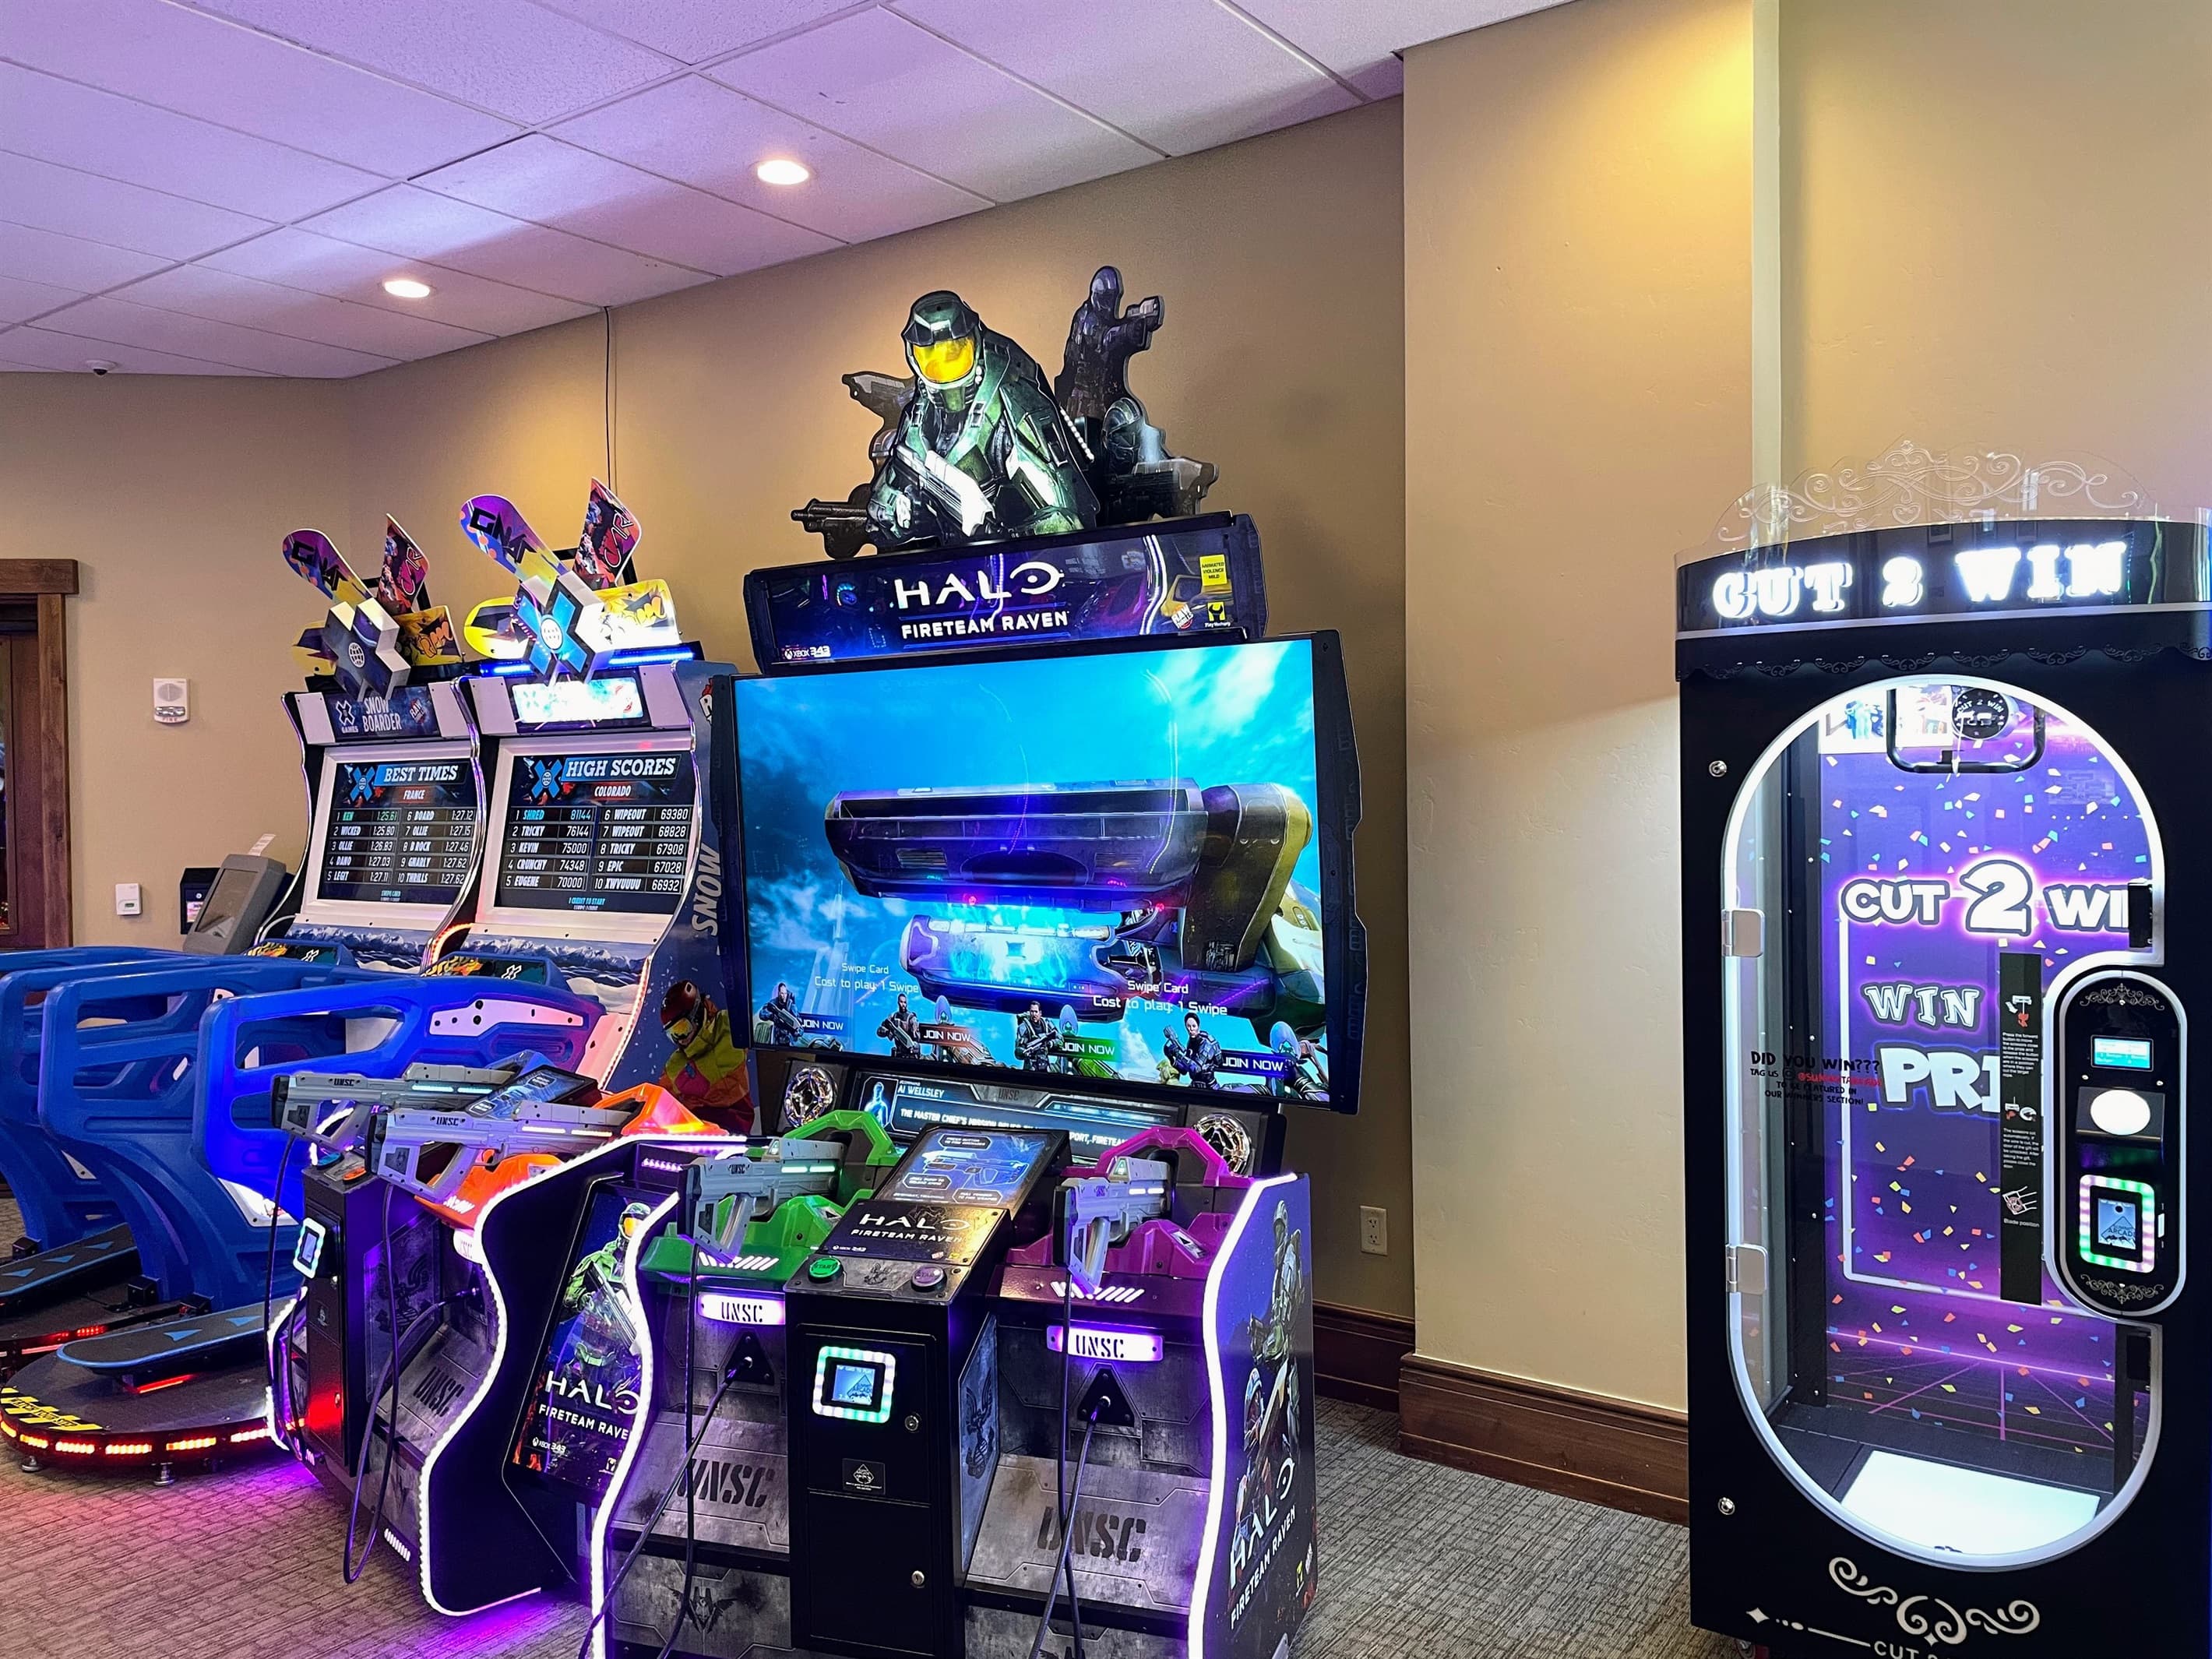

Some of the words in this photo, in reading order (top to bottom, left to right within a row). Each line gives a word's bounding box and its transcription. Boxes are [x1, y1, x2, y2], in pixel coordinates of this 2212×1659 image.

[894, 561, 1065, 609] HALO
[1713, 562, 1852, 619] CUT
[1956, 541, 2127, 602] WIN
[901, 618, 995, 639] FIRETEAM
[1002, 611, 1069, 632] RAVEN
[793, 649, 810, 657] XBOX
[810, 646, 830, 656] 343
[364, 696, 391, 715] SNOW
[341, 725, 359, 734] GAMES
[362, 713, 402, 733] BOARDER
[384, 766, 417, 783] BEST
[418, 765, 458, 782] TIMES
[566, 760, 608, 777] HIGH
[611, 758, 676, 777] SCORES
[403, 790, 426, 800] FRANCE
[594, 785, 632, 797] COLORADO
[407, 812, 412, 821] 6
[523, 809, 544, 820] SHRED
[570, 809, 591, 820] 81144
[604, 809, 611, 820] 6
[614, 808, 647, 820] WIPEOUT
[660, 808, 689, 820] 69380
[333, 826, 339, 836] 2
[405, 826, 410, 836] 7
[512, 826, 518, 837] 2
[521, 826, 545, 837] TRICKY
[566, 825, 590, 837] 76144
[603, 826, 608, 837] 7
[611, 826, 645, 837] WIPEOUT
[658, 825, 686, 837] 68828
[331, 841, 336, 851] 3
[403, 841, 408, 851] 8
[510, 843, 516, 853] 3
[518, 842, 539, 854] KEVIN
[562, 842, 587, 854] 75000
[600, 844, 606, 854] 8
[609, 843, 636, 854] TRICKY
[657, 843, 684, 855] 67908
[368, 856, 391, 867] 1:27.03
[401, 858, 406, 867] 9
[443, 858, 467, 868] 1:27.62
[508, 859, 514, 869] 4
[516, 859, 548, 870] CRUNCHY
[559, 859, 585, 871] 74348
[597, 861, 604, 872] 9
[607, 860, 624, 872] EPIC
[653, 861, 682, 873] 67028
[327, 872, 332, 881] 5
[398, 872, 404, 882] 10
[505, 875, 511, 886] 5
[514, 875, 540, 887] EUGENE
[557, 876, 583, 888] 70000
[594, 878, 603, 889] 10
[651, 879, 680, 891] 66932
[691, 842, 723, 936] SNOW
[1844, 881, 1947, 923] CUT
[1961, 858, 2031, 934] 2
[2046, 886, 2129, 931] WI
[842, 963, 866, 974] Swipe
[869, 963, 889, 974] Card
[815, 976, 837, 988] Cost
[840, 978, 851, 988] to
[881, 980, 886, 991] 1
[889, 981, 919, 994] Swipe
[1127, 980, 1160, 993] Swipe
[1163, 981, 1189, 994] Card
[1093, 995, 1122, 1008] Cost
[1125, 998, 1139, 1010] to
[1178, 1000, 1183, 1012] 1
[1188, 1001, 1228, 1016] Swipe
[1864, 984, 1981, 1028] WIN
[801, 1019, 819, 1030] JOIN
[822, 1020, 844, 1031] NOW
[923, 1029, 944, 1041] JOIN
[946, 1030, 970, 1042] NOW
[1062, 1041, 1085, 1054] JOIN
[1088, 1043, 1115, 1056] NOW
[1223, 1055, 1250, 1068] JOIN
[1252, 1058, 1284, 1072] NOW
[1751, 1051, 1776, 1065] DID
[1783, 1055, 1816, 1069] YOU
[1823, 1058, 1879, 1074] WIN???
[1768, 1069, 1779, 1078] US
[333, 1078, 355, 1087] UNSC
[1879, 1047, 2000, 1114] PRI
[907, 1086, 945, 1098] WELLSLEY
[1765, 1090, 1782, 1099] OUR
[1827, 1096, 1864, 1105] SECTION!
[435, 1116, 460, 1126] UNSC
[900, 1108, 913, 1118] THE
[914, 1111, 940, 1122] MASTER
[942, 1115, 967, 1125] CHIEF'S
[859, 1213, 970, 1231] HALO
[851, 1229, 915, 1240] FIRETEAM
[919, 1234, 963, 1243] RAVEN
[721, 1301, 763, 1323] UNSC
[1076, 1334, 1125, 1359] UNSC
[545, 1370, 640, 1415] HALO
[539, 1404, 595, 1430] FIRETEAM
[597, 1421, 629, 1440] RAVE
[551, 1442, 567, 1453] 343
[676, 1458, 775, 1509] UNSC
[1230, 1457, 1295, 1590] HALO
[1036, 1505, 1147, 1563] UNSC
[1231, 1548, 1270, 1630] FIRETEAM
[1272, 1505, 1296, 1557] RAVEN
[1874, 1640, 1919, 1659] CUT
